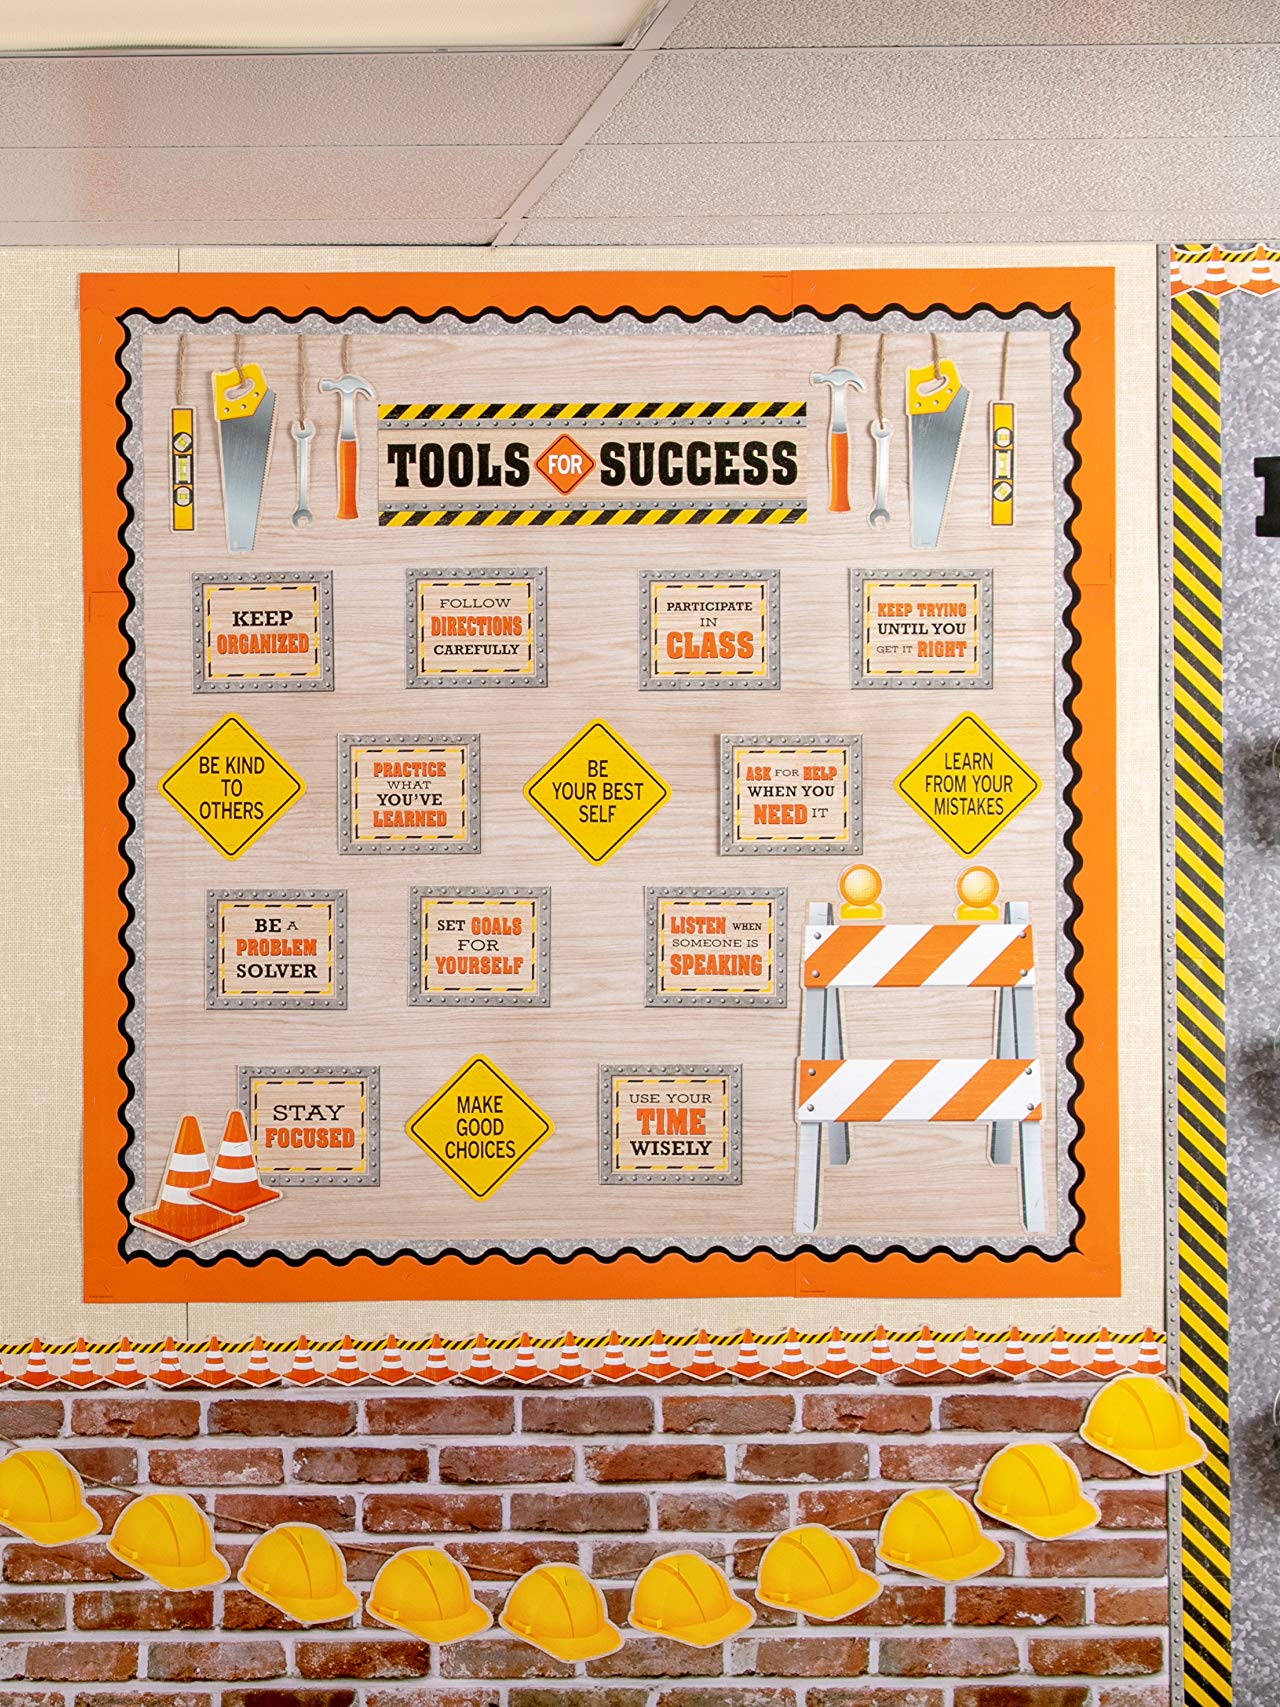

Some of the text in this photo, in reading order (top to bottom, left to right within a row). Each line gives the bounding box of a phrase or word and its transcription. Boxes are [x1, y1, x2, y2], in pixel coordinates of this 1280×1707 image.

[388, 441, 797, 487] TOOLS FOR SUCCESS
[440, 599, 511, 608] FOLLOW
[667, 602, 752, 611] PARTICIPATE
[878, 603, 966, 617] KEEP TRYING
[233, 611, 293, 626] KEEP
[431, 616, 522, 636] DIRECTIONS
[700, 618, 717, 627] IN
[878, 623, 966, 634] UNTIL YOU
[217, 633, 309, 654] ORGANIZED
[434, 645, 519, 655] CAREFULLY
[667, 631, 754, 659] CLASS
[876, 646, 898, 654] GET
[918, 641, 967, 657] RIGHT
[200, 757, 264, 774] BE KIND
[374, 762, 446, 777] PRACTICE
[588, 760, 608, 777] BE
[945, 753, 992, 770] LEARN
[746, 767, 771, 781] ASK
[803, 766, 837, 780] HELP
[221, 779, 242, 797] TO
[387, 781, 431, 789] WHAT
[552, 782, 643, 800] YOUR BEST
[748, 786, 834, 797] WHEN YOU
[926, 775, 1012, 792] FROM YOUR
[377, 794, 442, 806] YOU'VE
[935, 797, 1003, 815] MISTAKES
[200, 802, 263, 819] OTHERS
[373, 810, 447, 827] LEARNED
[579, 805, 616, 822] SELF
[754, 804, 828, 824] NEED IT
[255, 919, 298, 932] BE A
[438, 917, 522, 935] SET GOALS
[671, 916, 726, 934] LISTEN
[237, 939, 317, 956] PROBLEM
[458, 940, 499, 951] FOR
[673, 939, 741, 947] SOMEONE
[237, 964, 317, 978] SOLVER
[436, 956, 523, 974] YOURSELF
[670, 954, 762, 976] SPEAKING
[458, 1096, 503, 1113] MAKE
[629, 1094, 712, 1103] USE YOUR
[274, 1105, 344, 1121] STAY
[637, 1108, 706, 1135] TIME
[456, 1118, 505, 1137] GOOD
[265, 1128, 354, 1148] FOCUSED
[445, 1141, 515, 1159] CHOICES
[630, 1141, 712, 1155] WISELY
